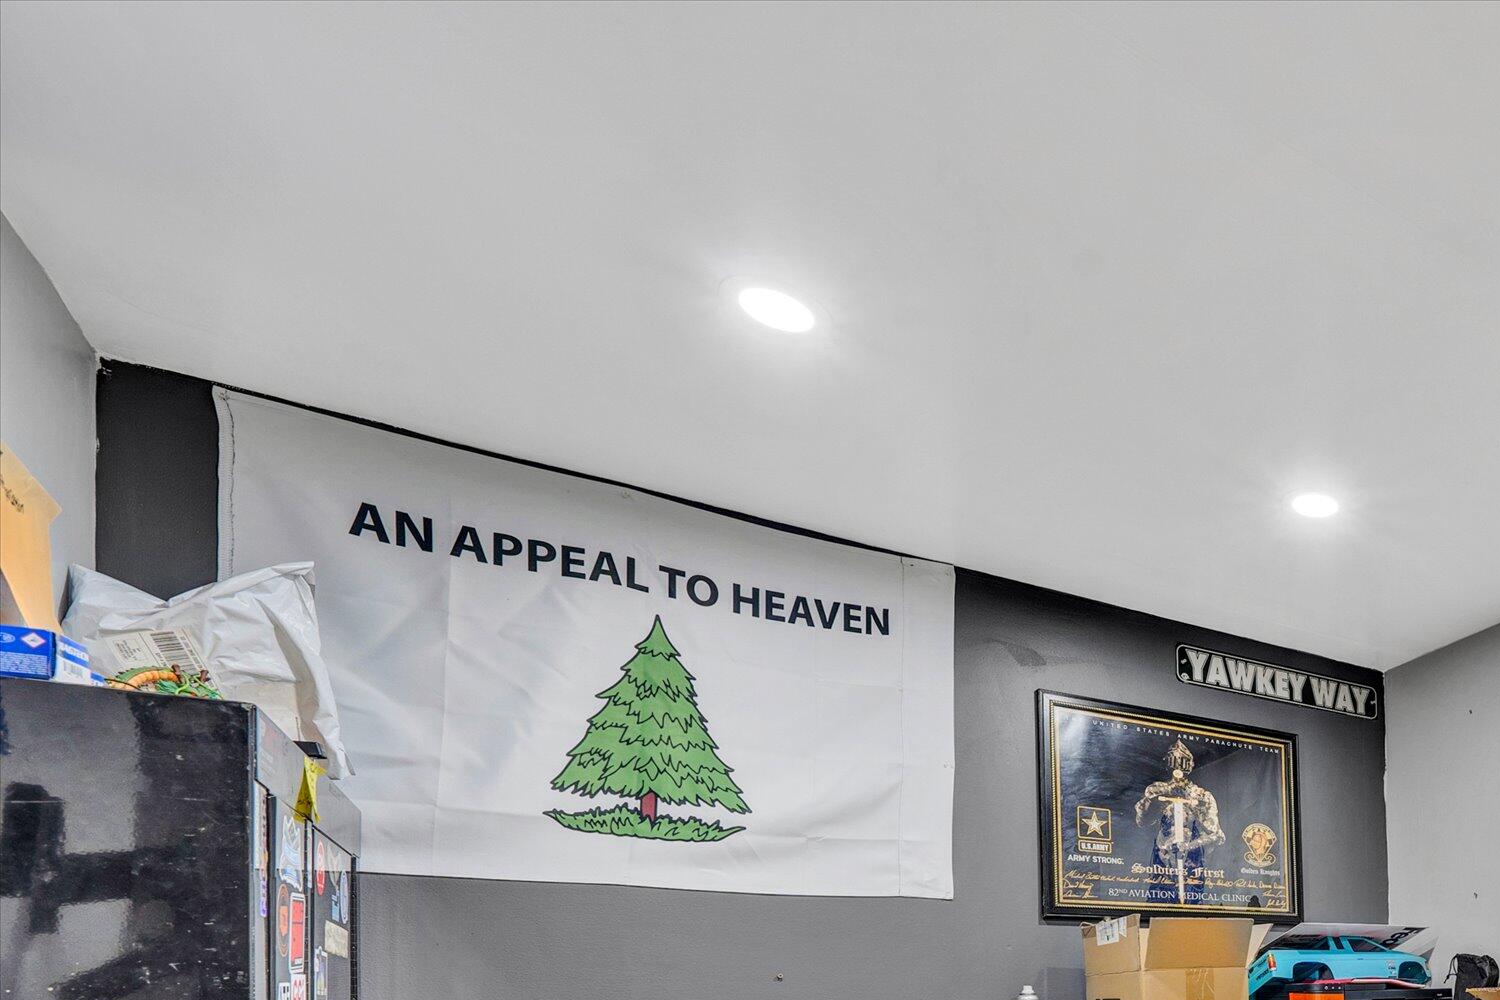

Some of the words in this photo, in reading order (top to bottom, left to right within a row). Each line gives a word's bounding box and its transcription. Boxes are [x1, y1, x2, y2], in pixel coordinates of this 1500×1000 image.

[349, 502, 433, 553] AN
[450, 525, 650, 593] APPEAL
[659, 565, 719, 607] TO
[733, 583, 890, 635] HEAVEN
[1185, 649, 1308, 703] YAWKEY
[1309, 676, 1371, 715] WAY
[1092, 720, 1129, 731] UNITED
[1136, 727, 1170, 737] STATES
[1177, 733, 1200, 742] ARMY
[1205, 737, 1253, 750] PARACHUTE
[1260, 746, 1280, 754] TEAM
[1067, 854, 1091, 862] ARMY
[1131, 862, 1188, 875] Soldiers
[1190, 867, 1225, 879] First
[1128, 889, 1176, 899] AVIATION
[1221, 893, 1252, 902] CLINIC
